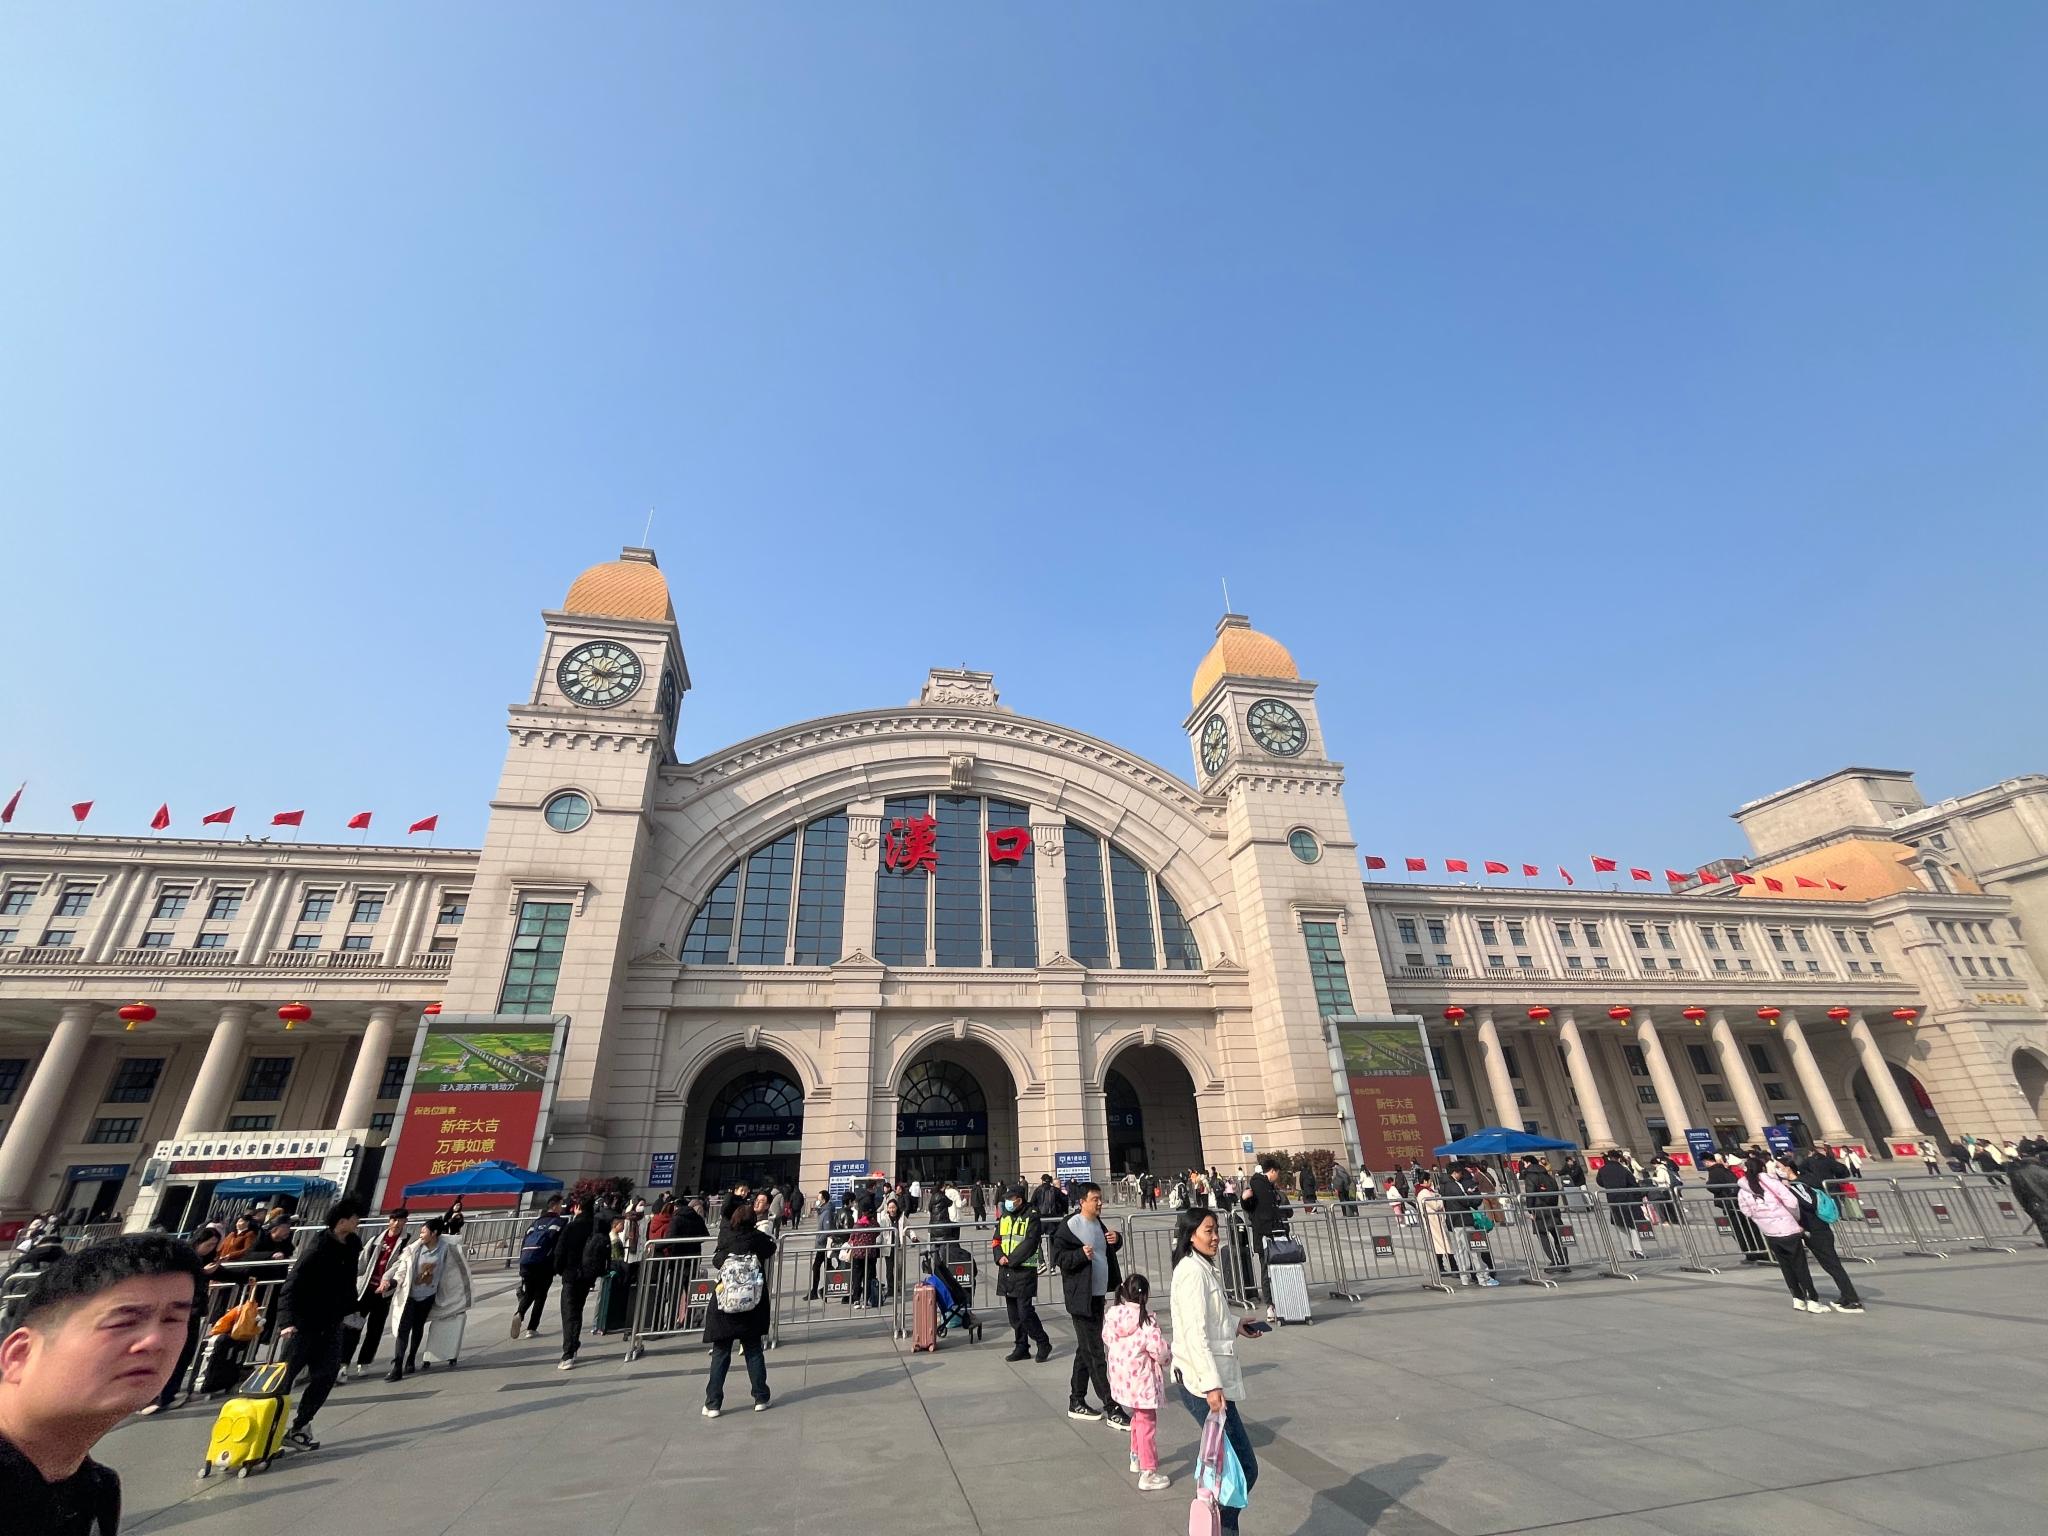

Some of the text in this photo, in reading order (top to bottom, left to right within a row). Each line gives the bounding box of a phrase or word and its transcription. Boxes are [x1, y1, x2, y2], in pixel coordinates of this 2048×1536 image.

[1376, 1098, 1413, 1109] 新年大吉
[440, 1118, 500, 1134] 新年大吉
[897, 1121, 904, 1132] 3
[967, 1118, 974, 1130] 4
[1126, 1114, 1133, 1126] 6
[720, 1125, 725, 1136] 1
[787, 1123, 795, 1135] 2
[435, 1138, 496, 1155] 万事如意
[828, 1282, 848, 1291] 汉口站
